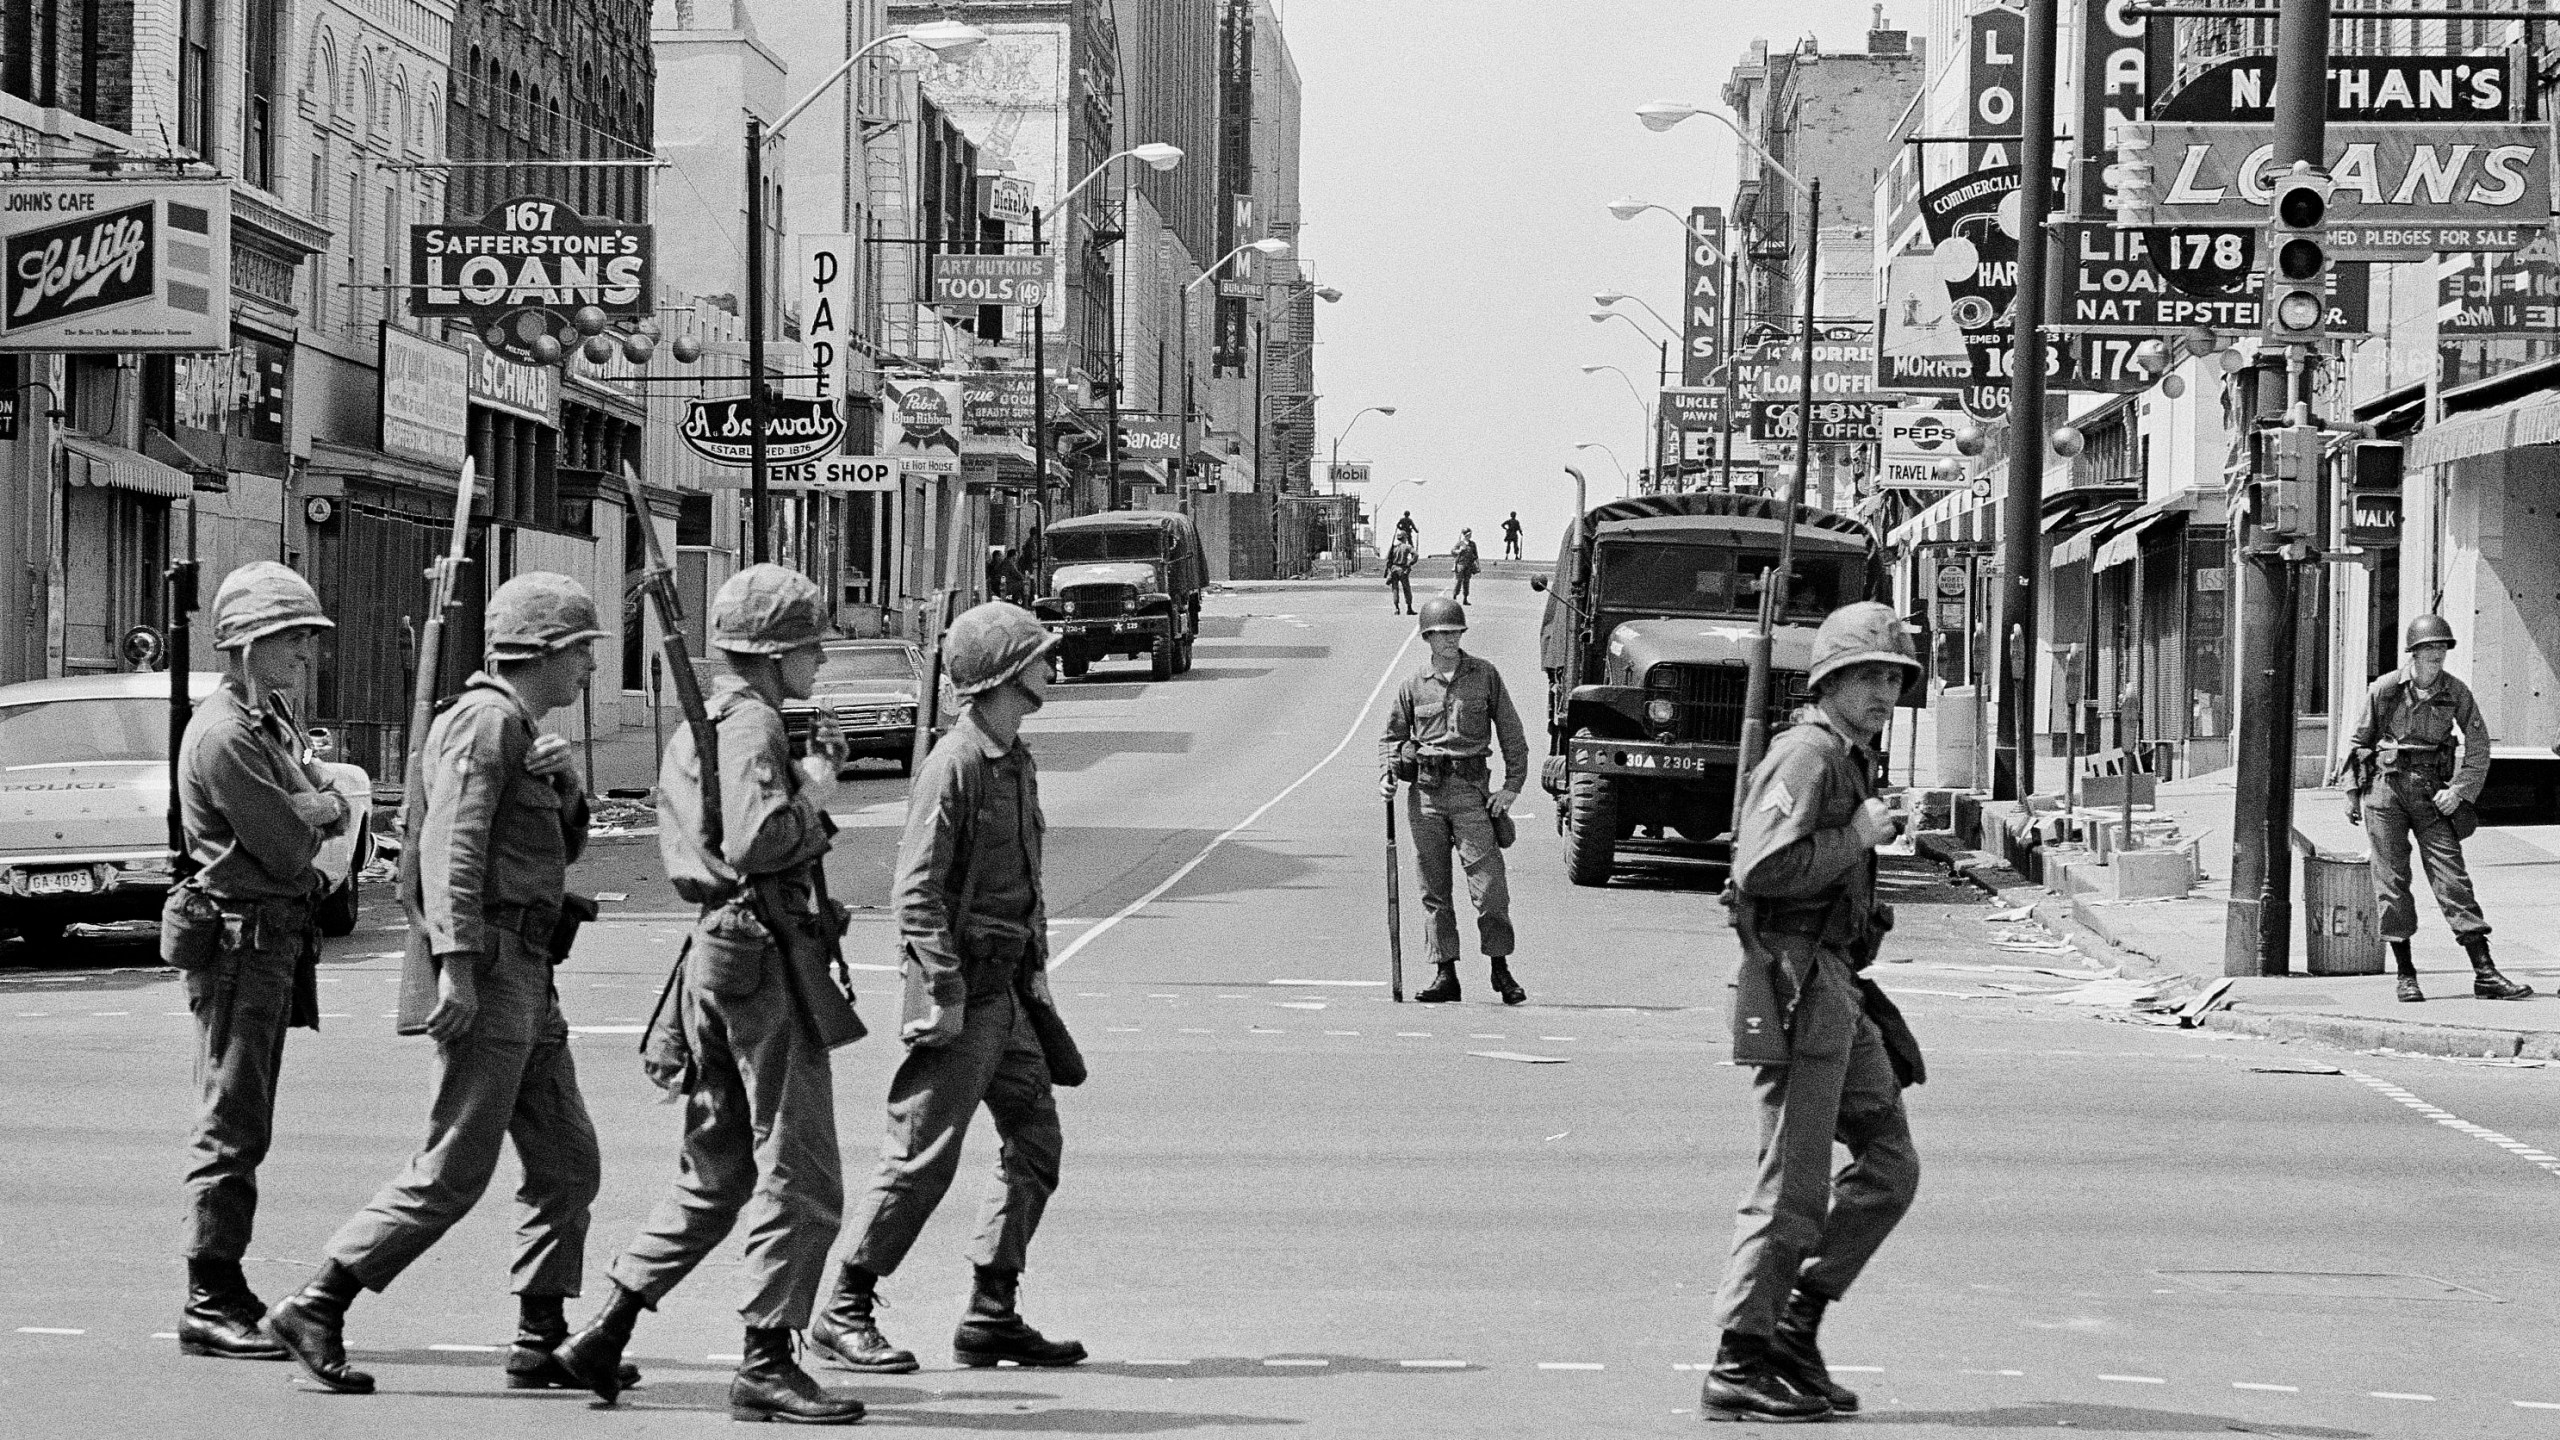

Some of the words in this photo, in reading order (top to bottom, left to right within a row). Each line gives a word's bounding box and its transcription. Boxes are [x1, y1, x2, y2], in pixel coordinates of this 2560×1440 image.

[2231, 65, 2502, 110] NHAN'S
[2161, 142, 2537, 206] LOANS
[4, 192, 52, 212] JOHN'S
[58, 193, 95, 211] CAFE
[1933, 174, 2022, 214] COMMERCIAL
[505, 201, 556, 231] 167
[426, 229, 638, 254] SAFFERSTONE'S
[2366, 230, 2432, 246] PLEDGES
[2440, 230, 2470, 246] FOR
[2476, 230, 2517, 245] SALE
[2170, 233, 2243, 270] 178
[13, 215, 145, 317] Schlitz
[939, 260, 970, 275] ART
[976, 260, 1043, 276] HUTKINS
[427, 255, 643, 306] LOANS
[937, 278, 1014, 299] TOOLS
[1223, 283, 1262, 296] BUILDING
[1692, 214, 1717, 358] LOANS
[1019, 283, 1040, 304] 149
[2076, 299, 2142, 321] NAT
[2157, 300, 2262, 324] EPSTEI
[1963, 334, 2001, 345] EEMED
[482, 348, 548, 412] SCHWAB
[906, 392, 941, 410] Pabst
[1676, 394, 1719, 409] UNCLE
[1969, 386, 2011, 409] 166
[722, 403, 837, 437] Scwab
[891, 411, 915, 424] Blue
[916, 410, 952, 424] Ribbon
[1682, 411, 1718, 421] PAWN
[1893, 426, 1956, 440] PEPS
[711, 443, 785, 457] ESTABLHED
[789, 443, 811, 455] 1876
[770, 463, 817, 482] ENS
[826, 463, 889, 483] SHOP
[1330, 468, 1368, 481] Mobil
[1889, 464, 1928, 481] TRAVEL
[2354, 509, 2396, 527] WALK
[1626, 753, 1643, 767] 30
[1662, 755, 1705, 771] 230-E
[4, 783, 115, 792] POLICE
